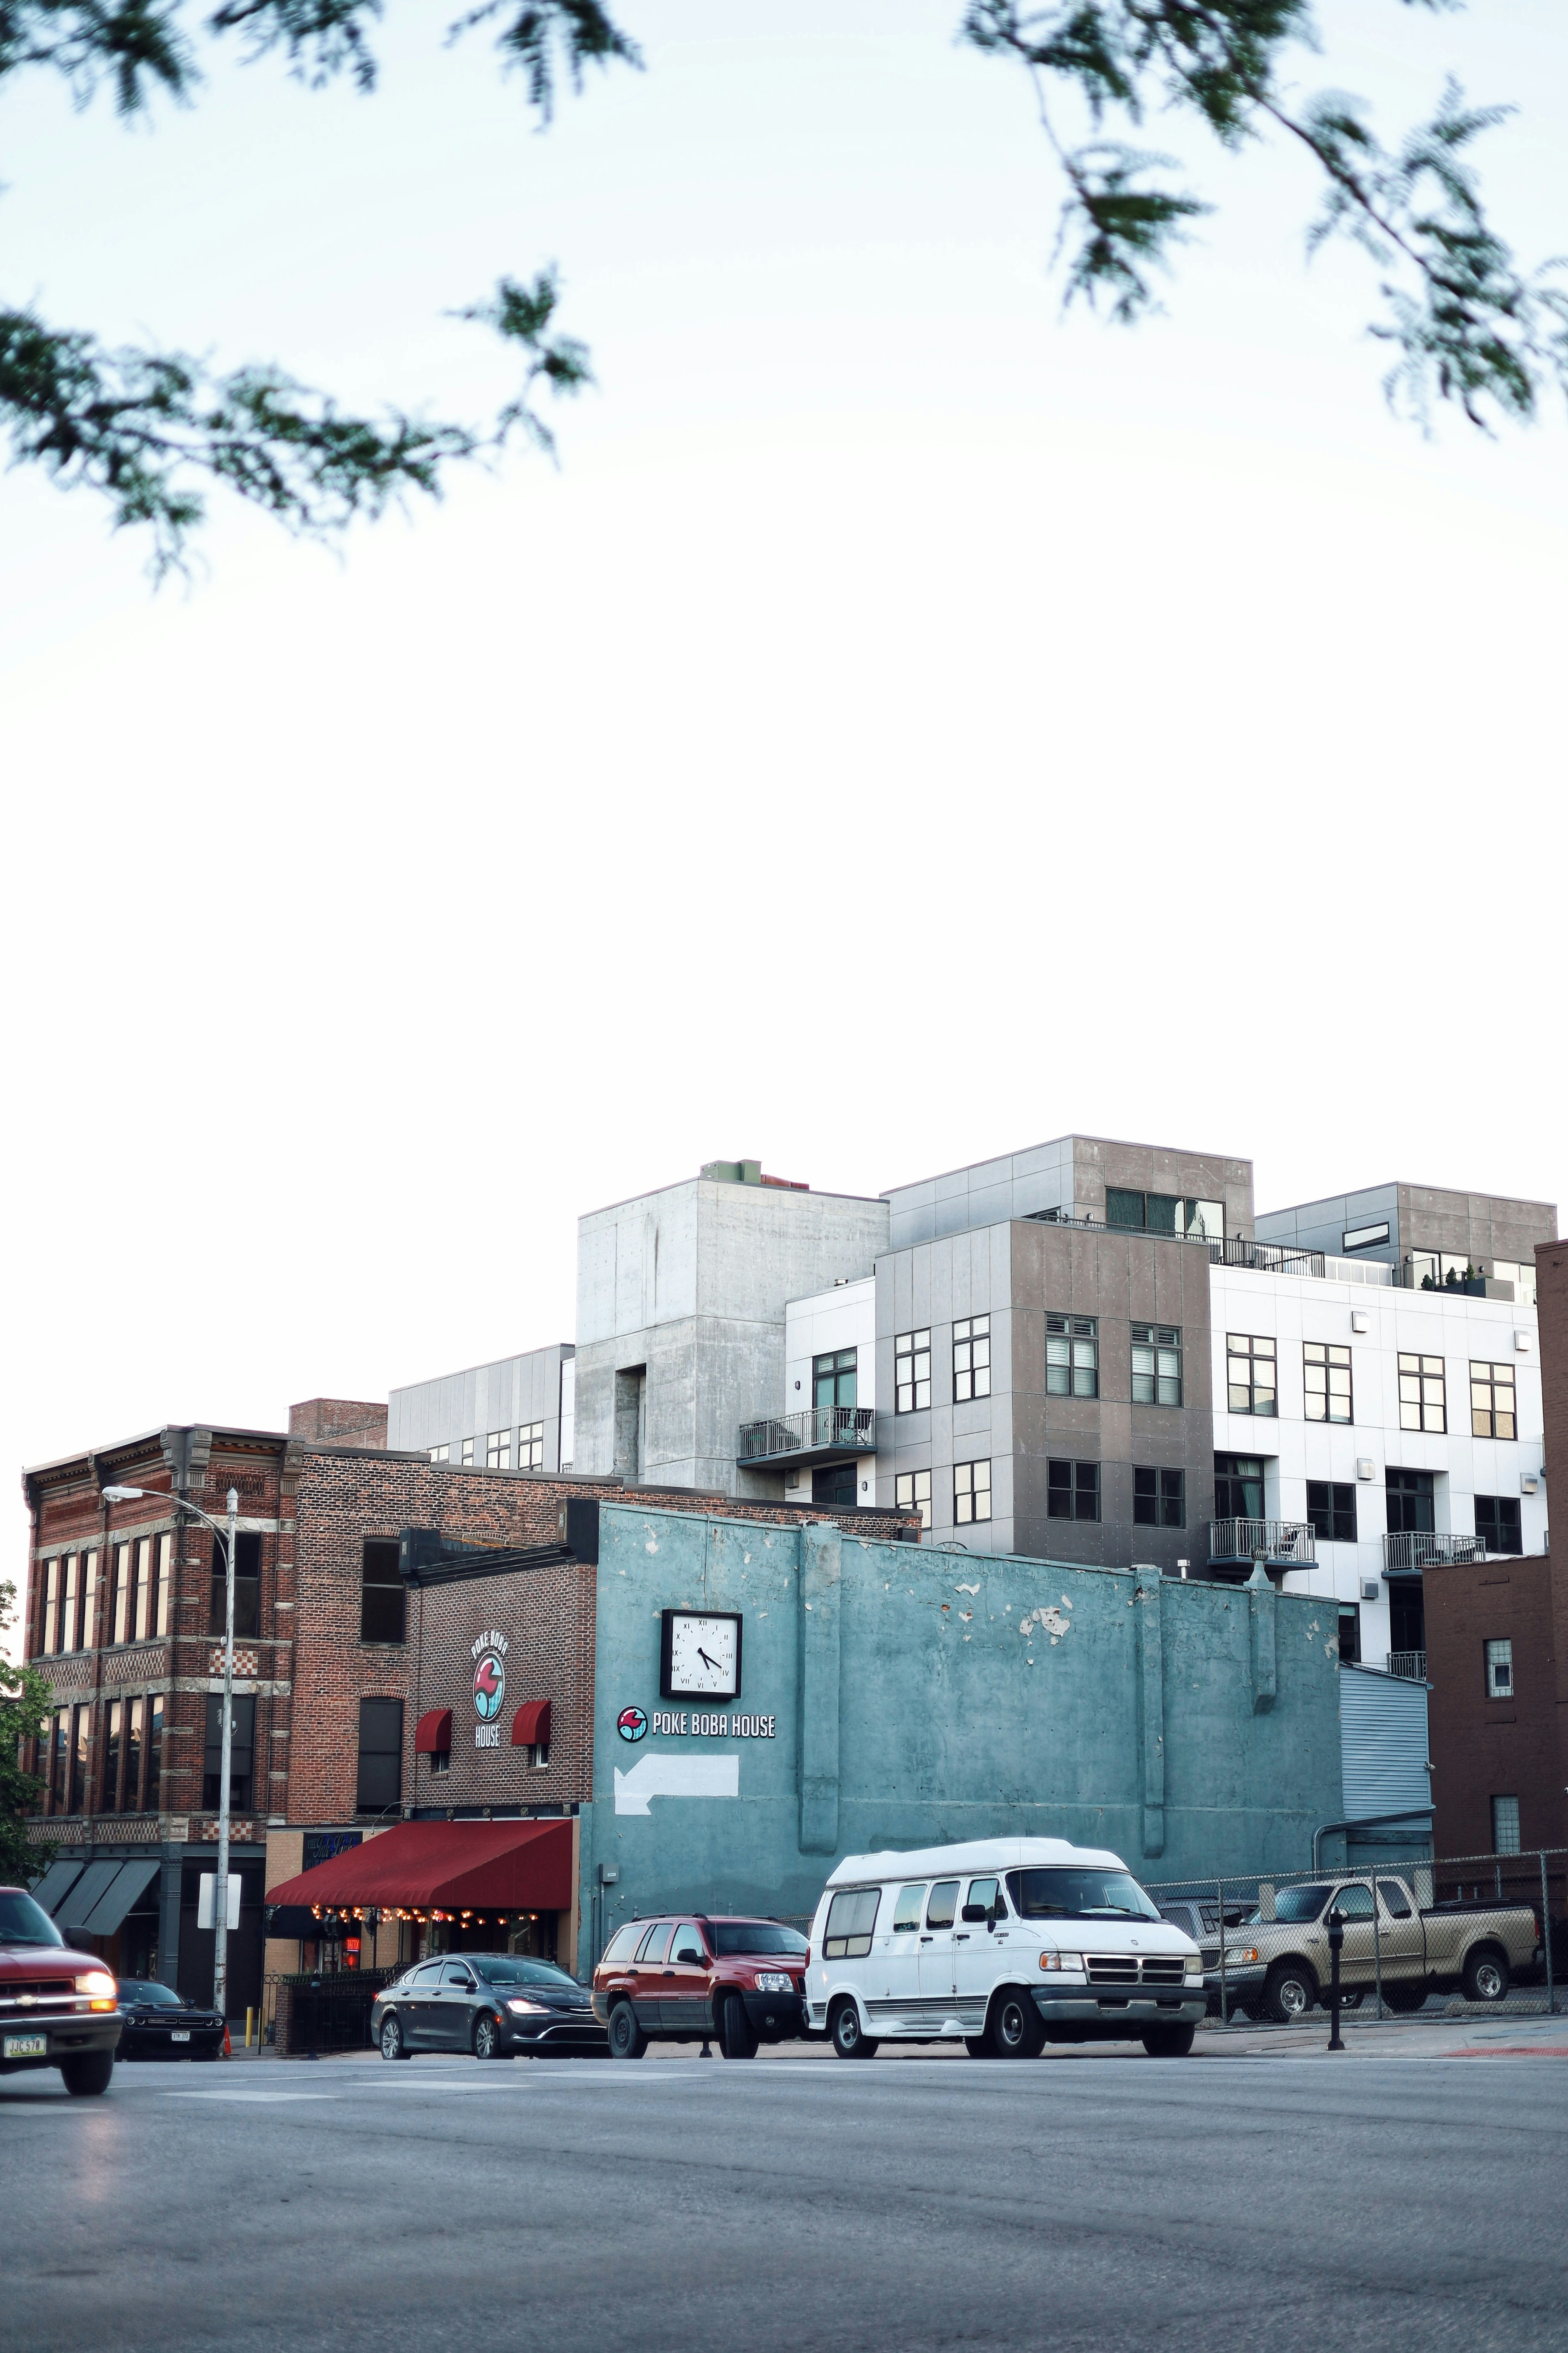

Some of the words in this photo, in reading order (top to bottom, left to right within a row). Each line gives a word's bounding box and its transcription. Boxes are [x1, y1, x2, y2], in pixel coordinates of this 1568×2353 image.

[471, 1631, 488, 1660] POKE
[490, 1630, 509, 1657] BOBA
[475, 1725, 500, 1748] HOUSE
[652, 1711, 688, 1735] POKE
[691, 1713, 728, 1736] BOBA
[731, 1714, 775, 1738] HOUSE
[10, 2041, 24, 2052] JJC
